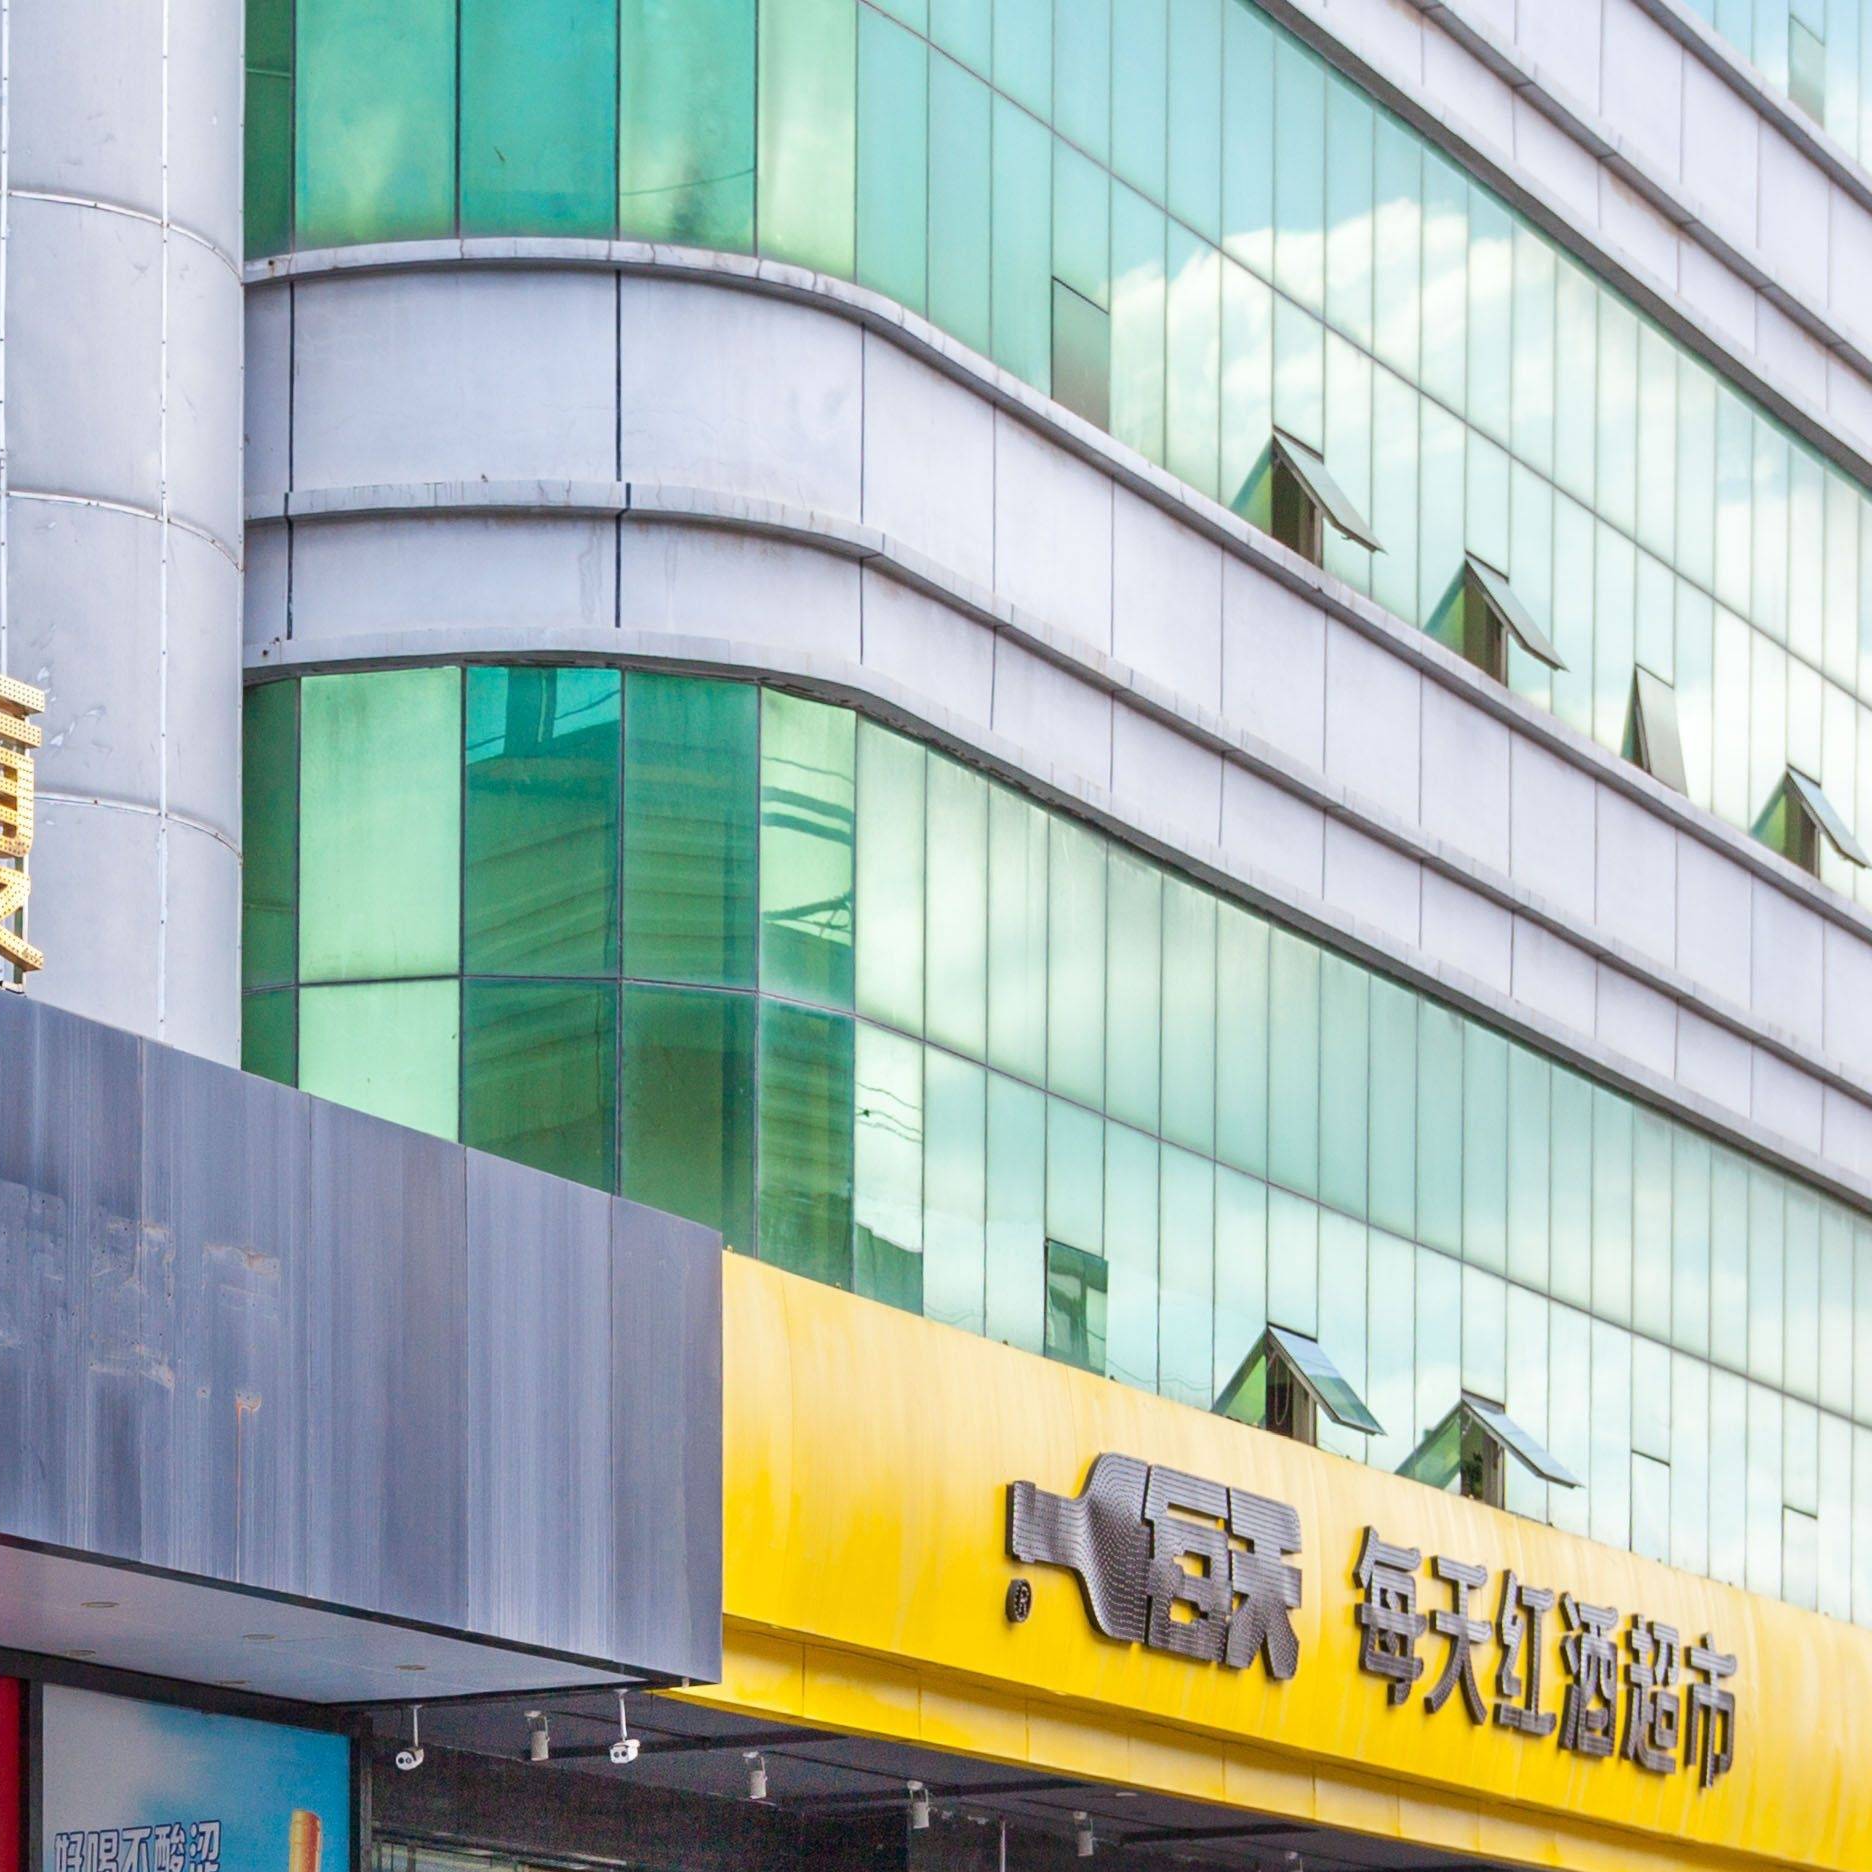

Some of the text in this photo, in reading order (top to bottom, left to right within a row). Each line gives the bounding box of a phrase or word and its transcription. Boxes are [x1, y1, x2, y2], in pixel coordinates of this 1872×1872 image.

[1352, 1524, 1740, 1789] 每天红酒超市
